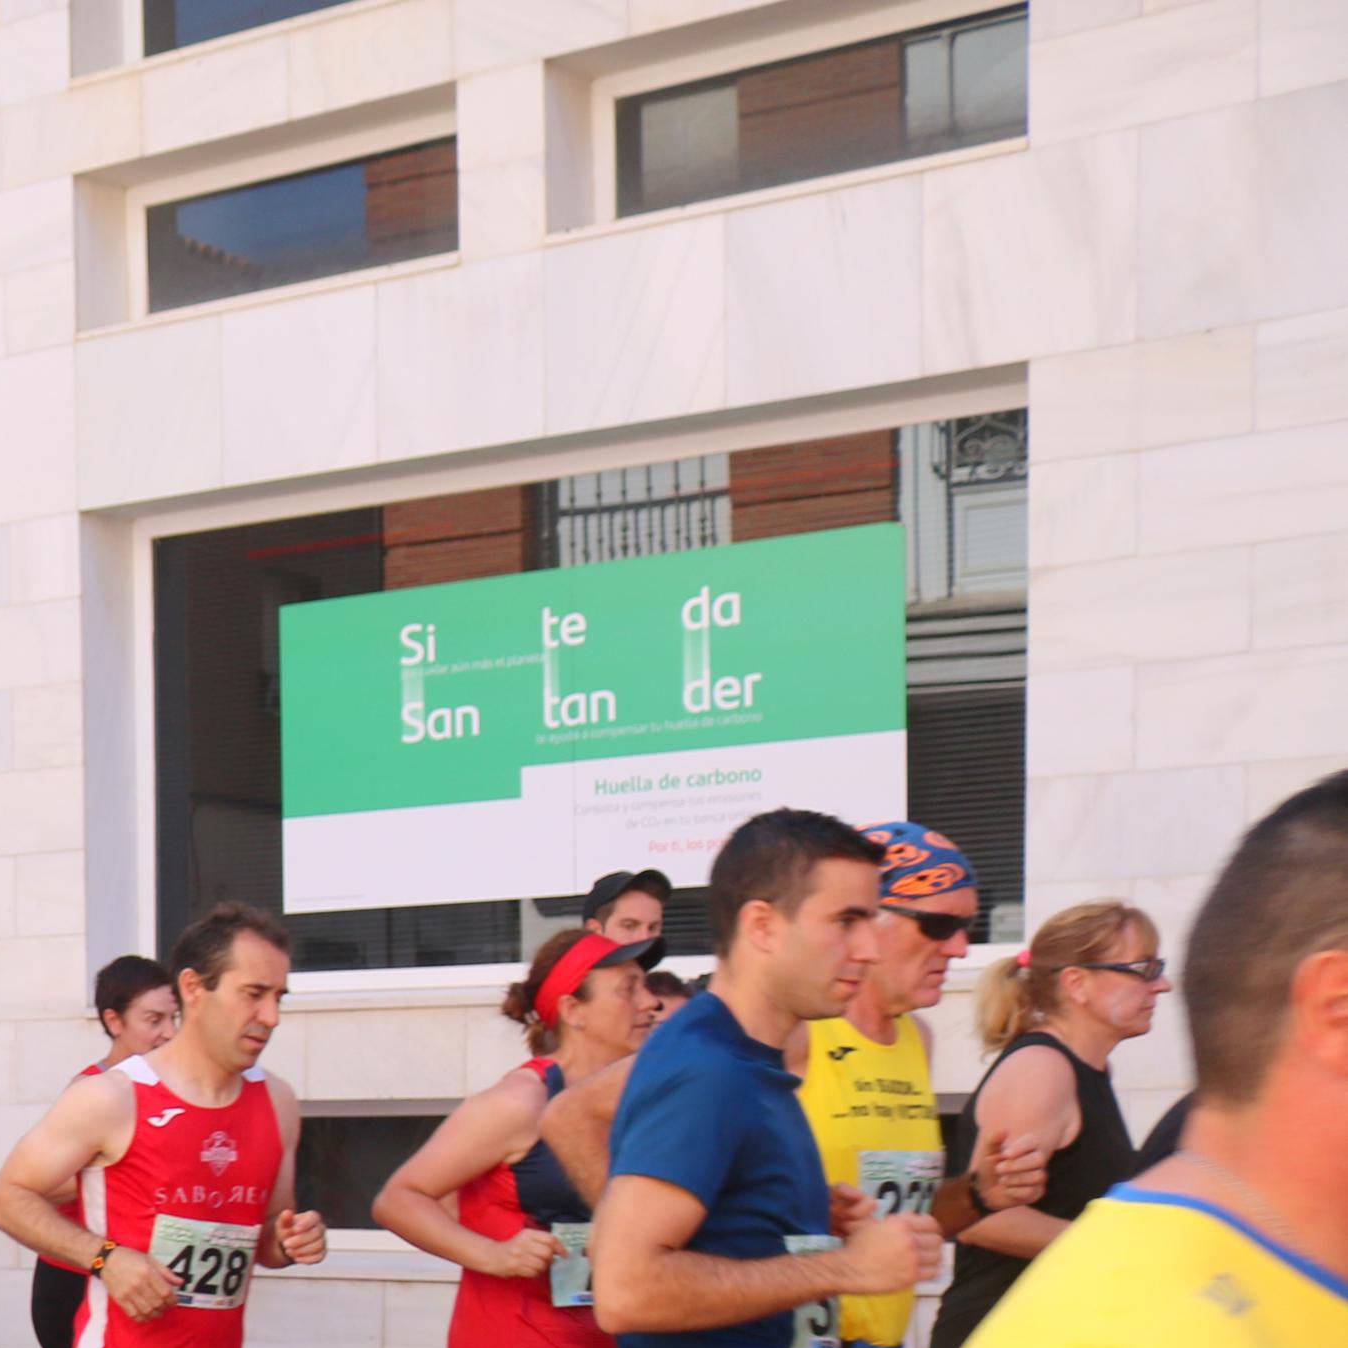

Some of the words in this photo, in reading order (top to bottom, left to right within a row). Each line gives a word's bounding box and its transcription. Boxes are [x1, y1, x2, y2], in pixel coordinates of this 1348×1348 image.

[400, 623, 436, 666] Si
[542, 606, 587, 648] te
[682, 585, 741, 631] da
[401, 702, 479, 744] San
[543, 686, 617, 728] tan
[683, 668, 763, 713] der
[594, 775, 654, 796] Huella
[658, 772, 681, 791] de
[686, 768, 762, 788] carbono
[168, 1245, 249, 1297] 428
